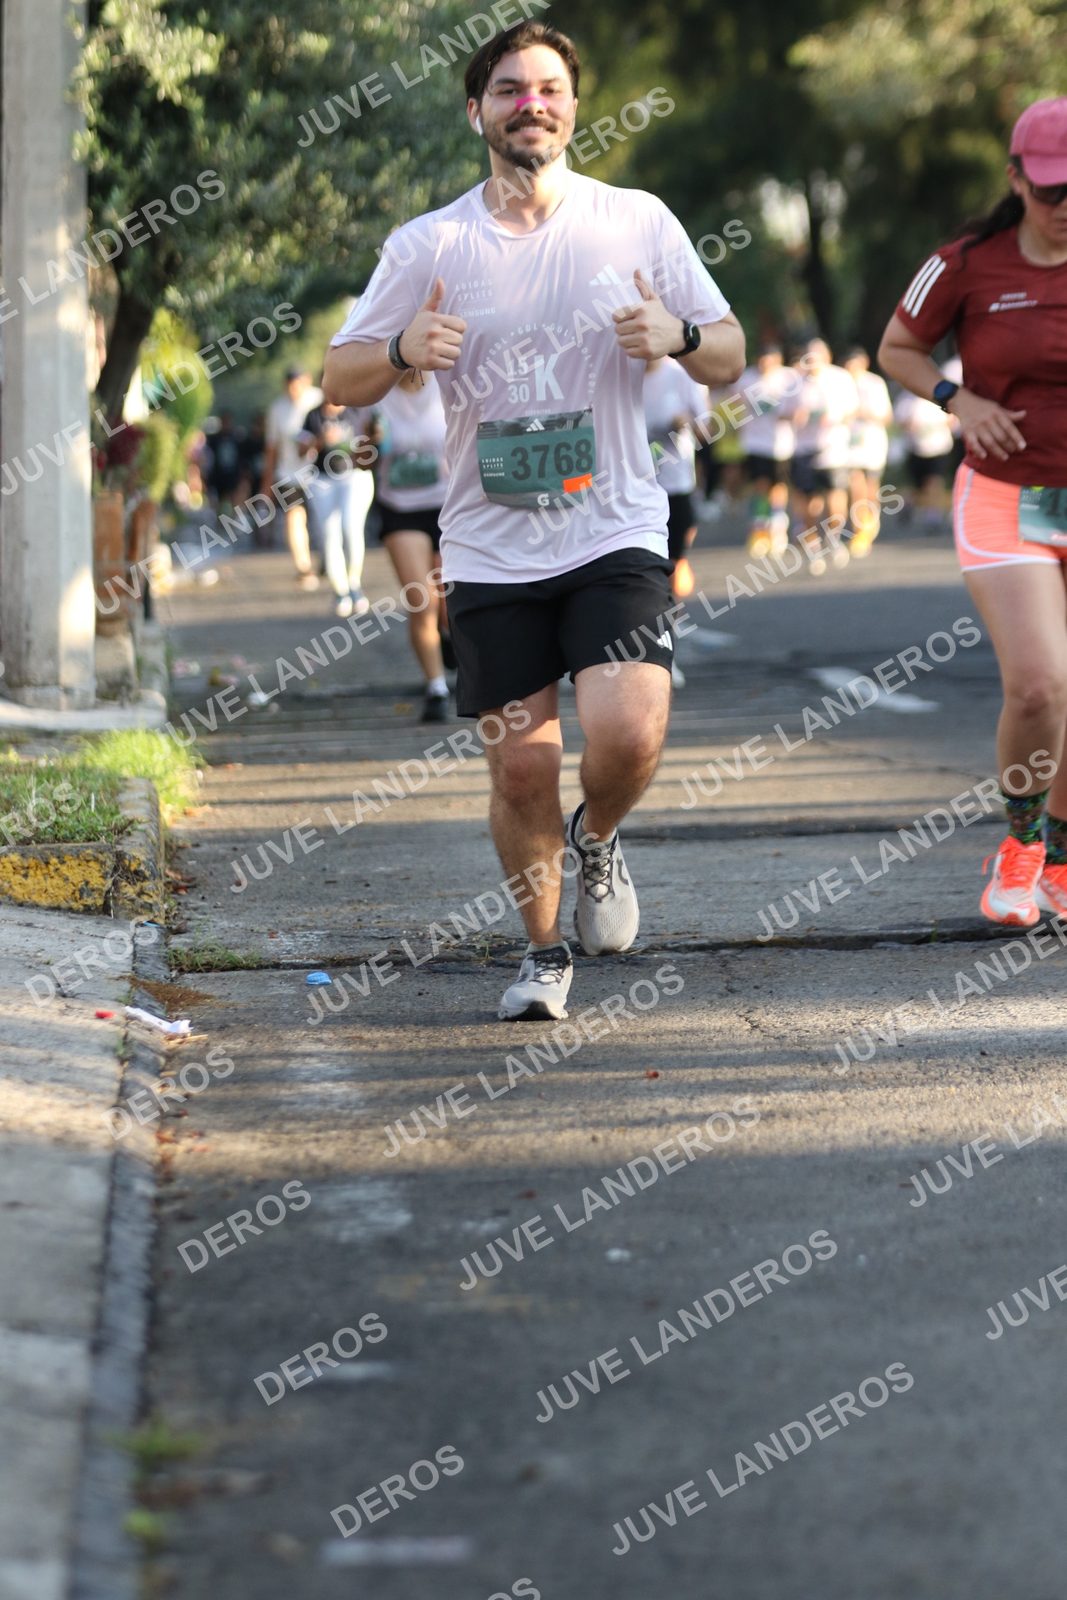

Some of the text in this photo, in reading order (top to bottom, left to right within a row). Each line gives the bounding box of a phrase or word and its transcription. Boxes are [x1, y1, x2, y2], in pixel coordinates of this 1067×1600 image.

[507, 383, 530, 404] 30
[534, 352, 564, 401] K
[510, 438, 593, 481] 3768
